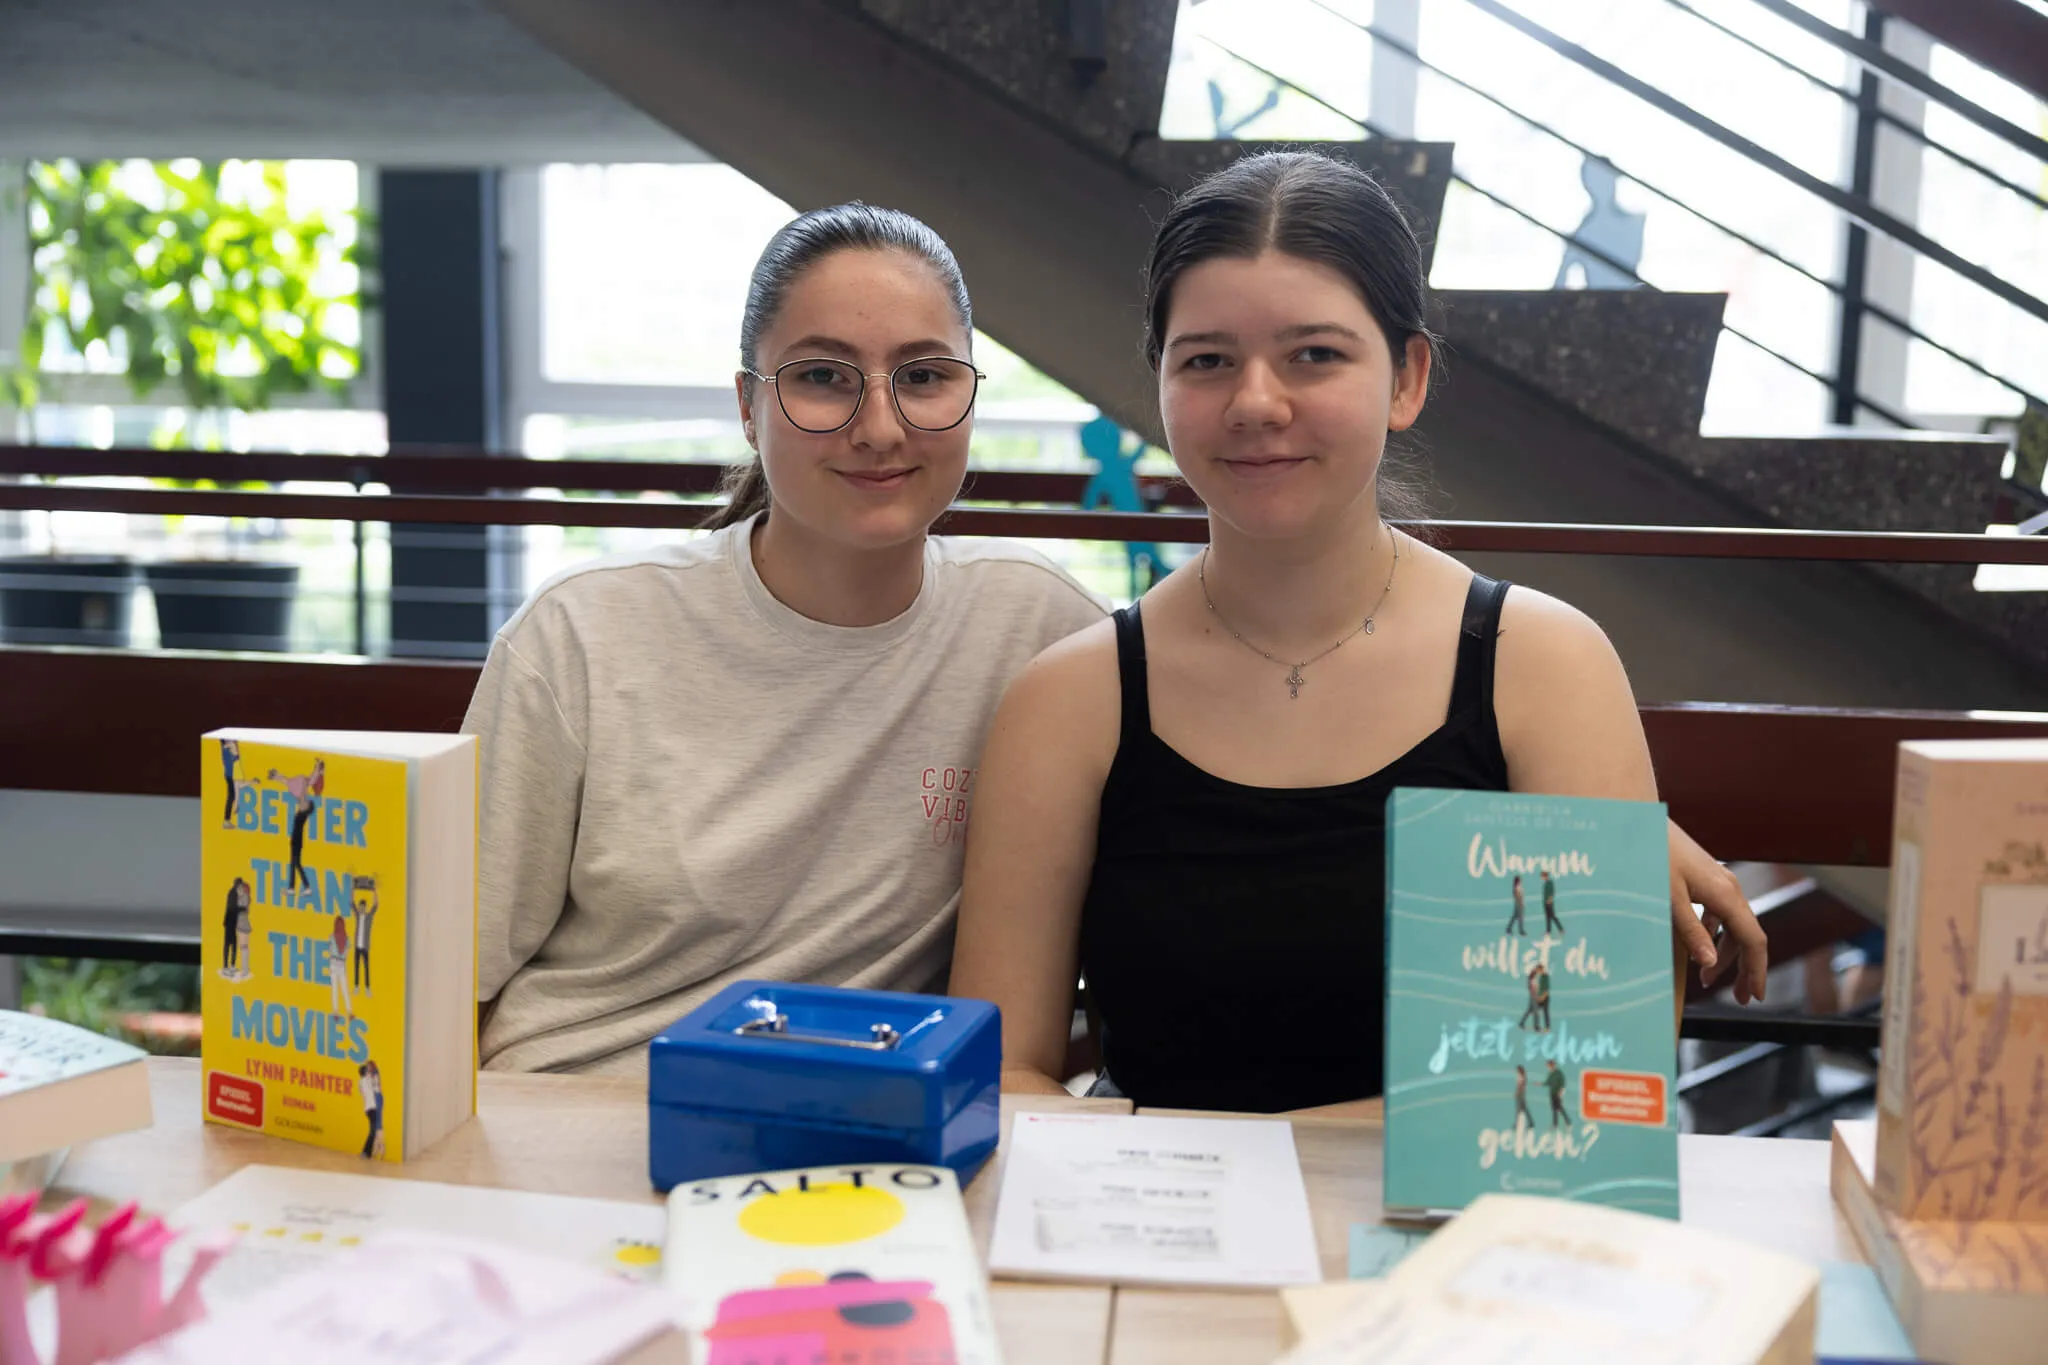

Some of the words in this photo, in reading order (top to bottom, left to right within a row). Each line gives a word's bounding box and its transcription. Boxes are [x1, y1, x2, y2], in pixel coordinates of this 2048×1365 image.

[922, 767, 979, 793] COZ
[237, 786, 369, 848] BETTER
[1467, 832, 1597, 879] Warum
[251, 858, 353, 918] THAN
[268, 931, 333, 986] THE
[1462, 934, 1562, 980] willst
[1564, 937, 1610, 980] du
[231, 995, 369, 1064] MOVIES
[1428, 1016, 1516, 1074] jetzt
[1524, 1019, 1624, 1065] schon
[246, 1058, 285, 1082] LYNN
[290, 1066, 353, 1096] PAINTER
[1478, 1112, 1600, 1169] gehen?
[690, 1166, 943, 1205] SALTO
